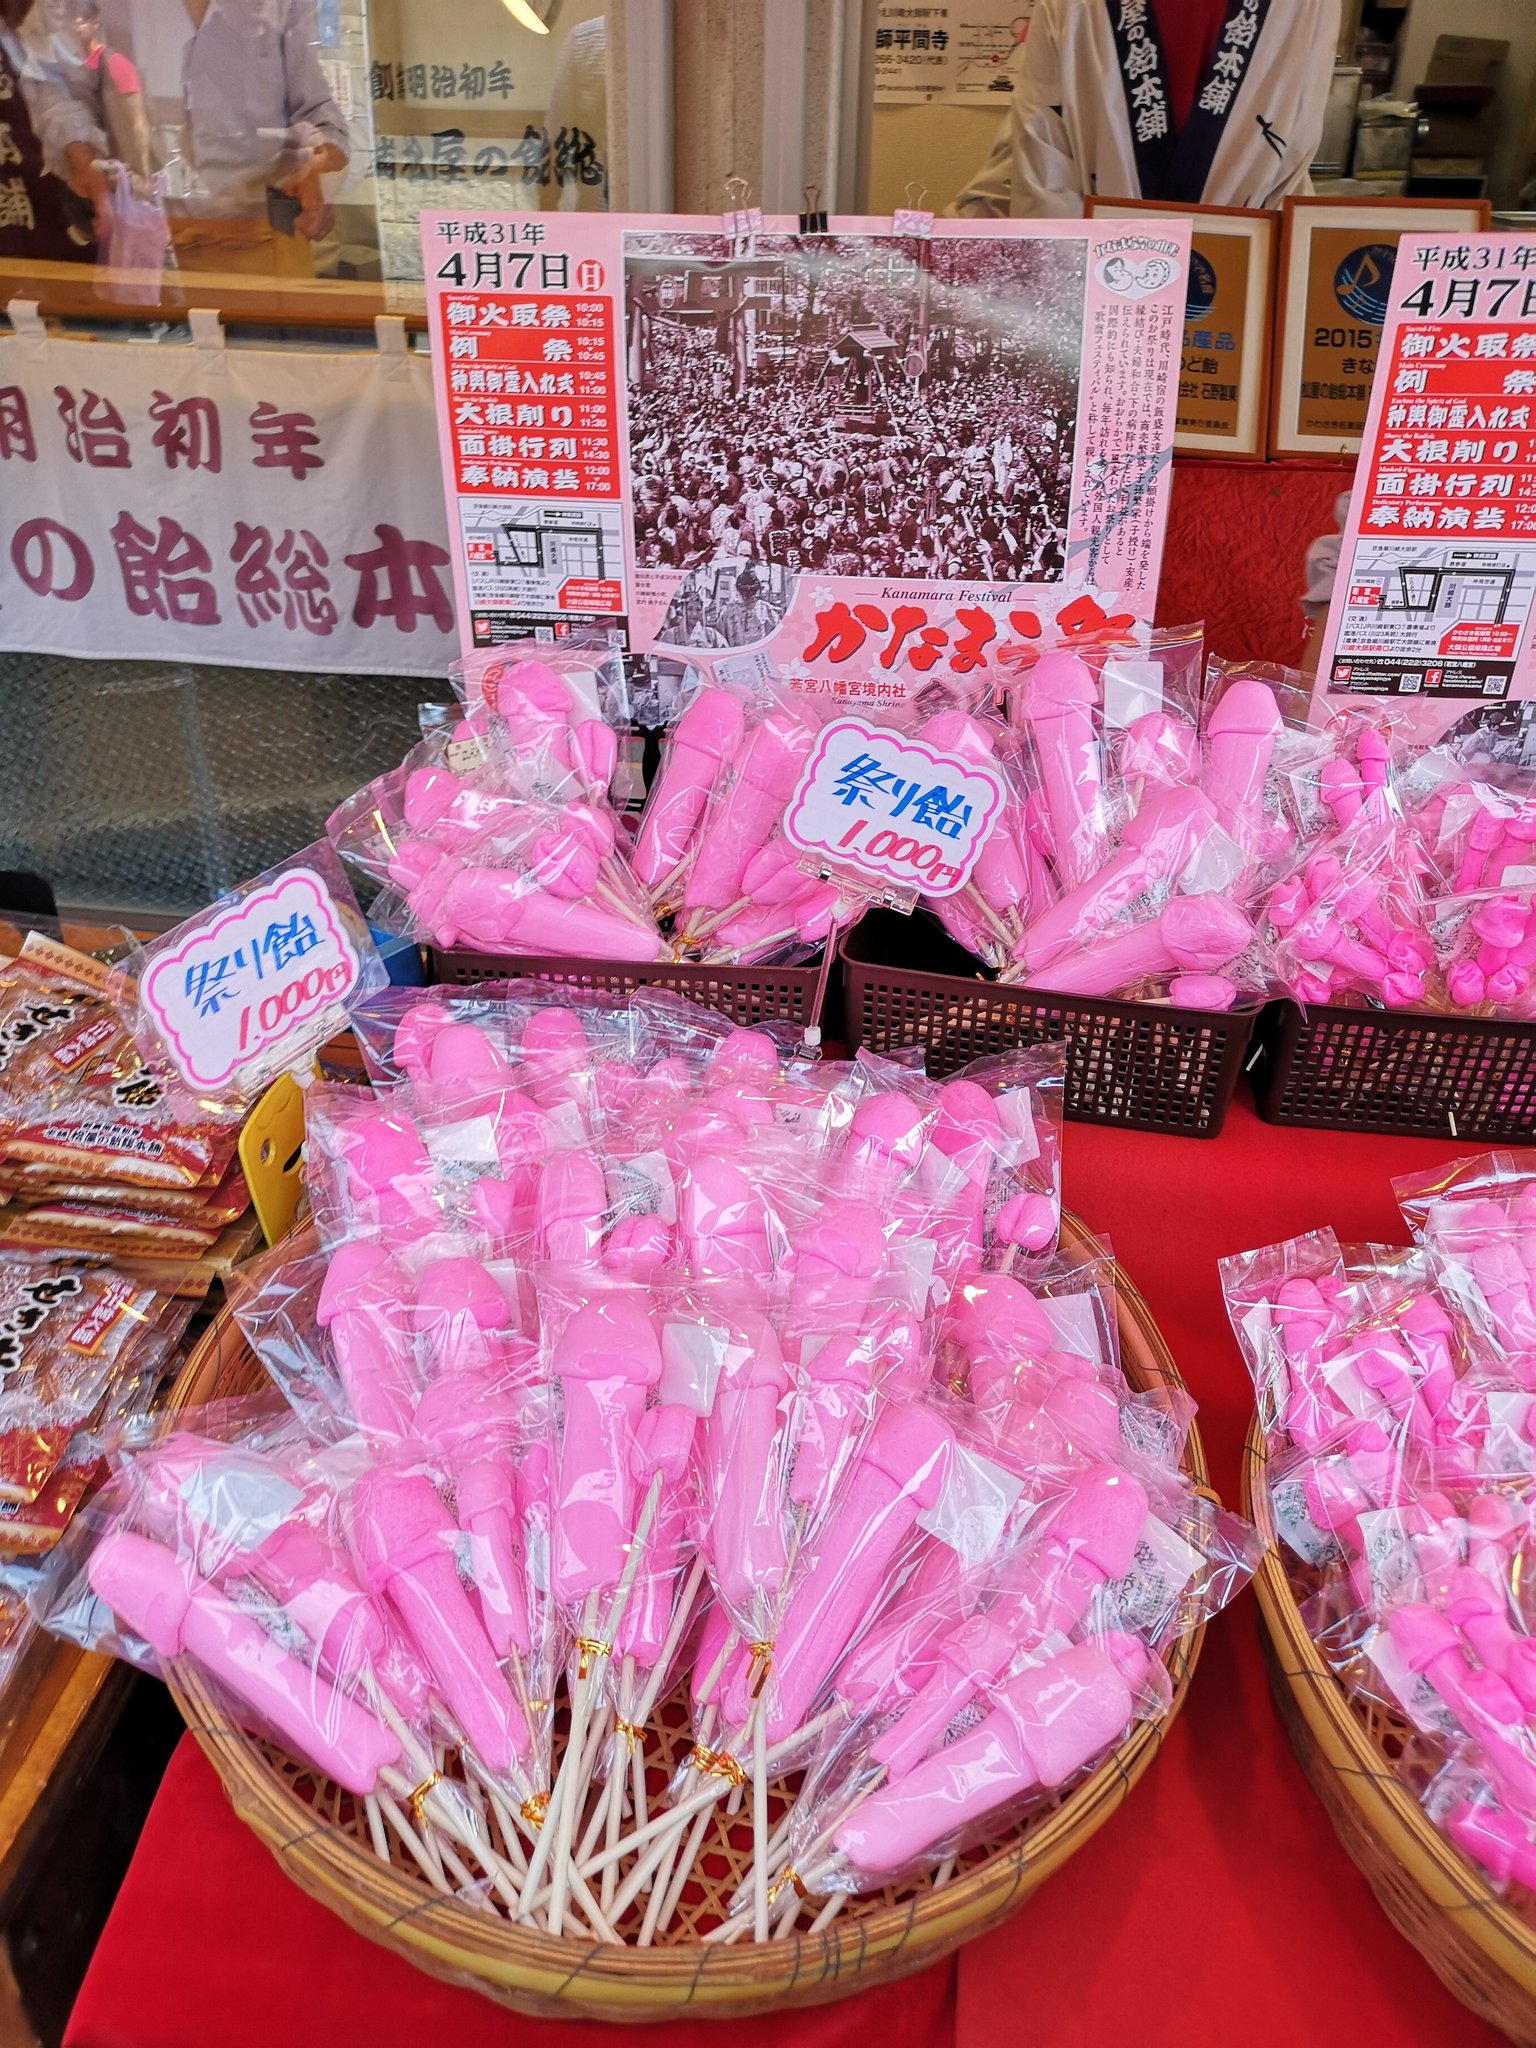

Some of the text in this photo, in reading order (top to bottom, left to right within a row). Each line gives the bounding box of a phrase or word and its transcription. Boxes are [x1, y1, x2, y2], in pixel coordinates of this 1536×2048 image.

[436, 222, 545, 246] 平成31年
[436, 251, 570, 289] 4月7日
[1412, 245, 1536, 272] 平成31年
[446, 301, 572, 328] 御火取祭
[449, 336, 479, 359] 例
[542, 338, 573, 362] 祭
[1314, 327, 1372, 349] 2015
[1400, 332, 1536, 359] 御火取祭
[1393, 368, 1536, 395] 例 祭
[454, 402, 574, 428] 大根削り
[456, 434, 578, 460] 面掛行列
[1379, 438, 1519, 464] 大根削り
[460, 464, 581, 491] 奉納演芸
[1375, 473, 1515, 498] 面掛行列
[1366, 504, 1507, 530] 奉納演芸
[10, 510, 457, 636] の飴総本
[881, 586, 1013, 604] Kanamara Festival
[789, 677, 907, 698] 若宮八幡宮境内社
[876, 699, 905, 708] Shrin
[831, 752, 974, 841] 祭り飴
[184, 911, 326, 1020] 祭り飴
